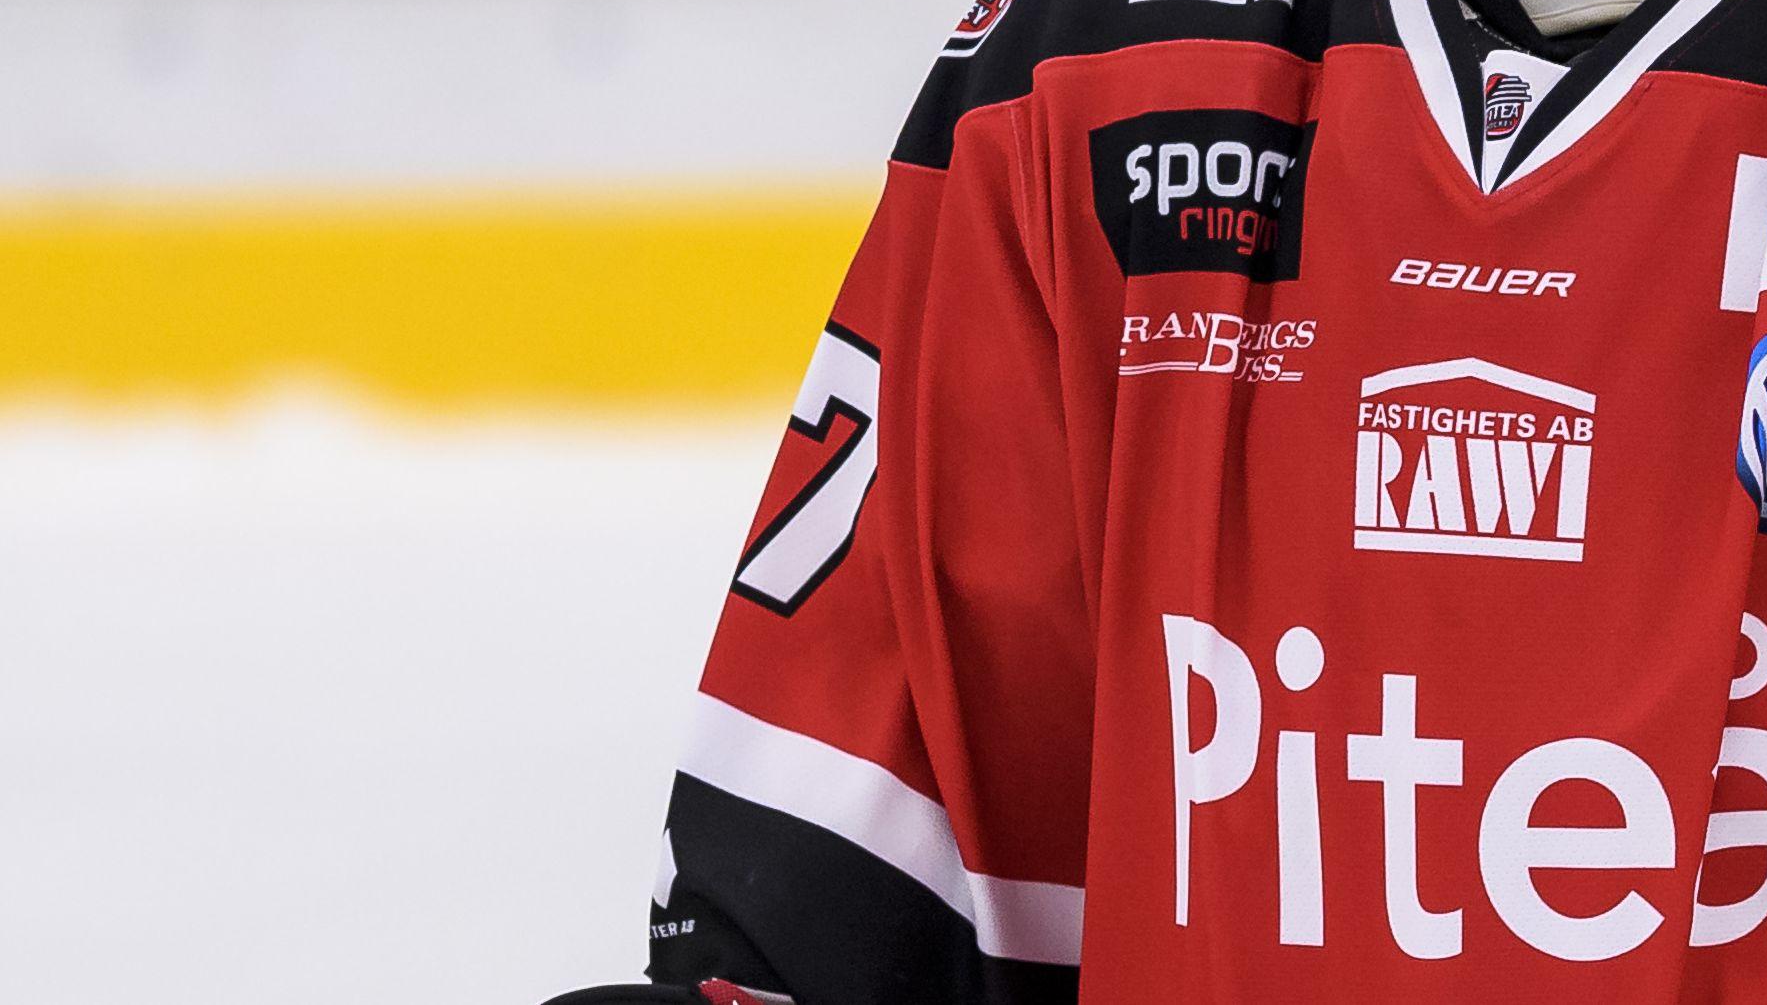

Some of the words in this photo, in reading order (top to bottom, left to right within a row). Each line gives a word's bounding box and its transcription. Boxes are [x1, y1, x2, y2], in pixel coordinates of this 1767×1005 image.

[1126, 141, 1296, 215] spor
[1389, 258, 1577, 297] BAUER
[1358, 402, 1536, 438] FASTIGHETS
[1547, 415, 1594, 442] AB
[1354, 430, 1592, 539] RAWI
